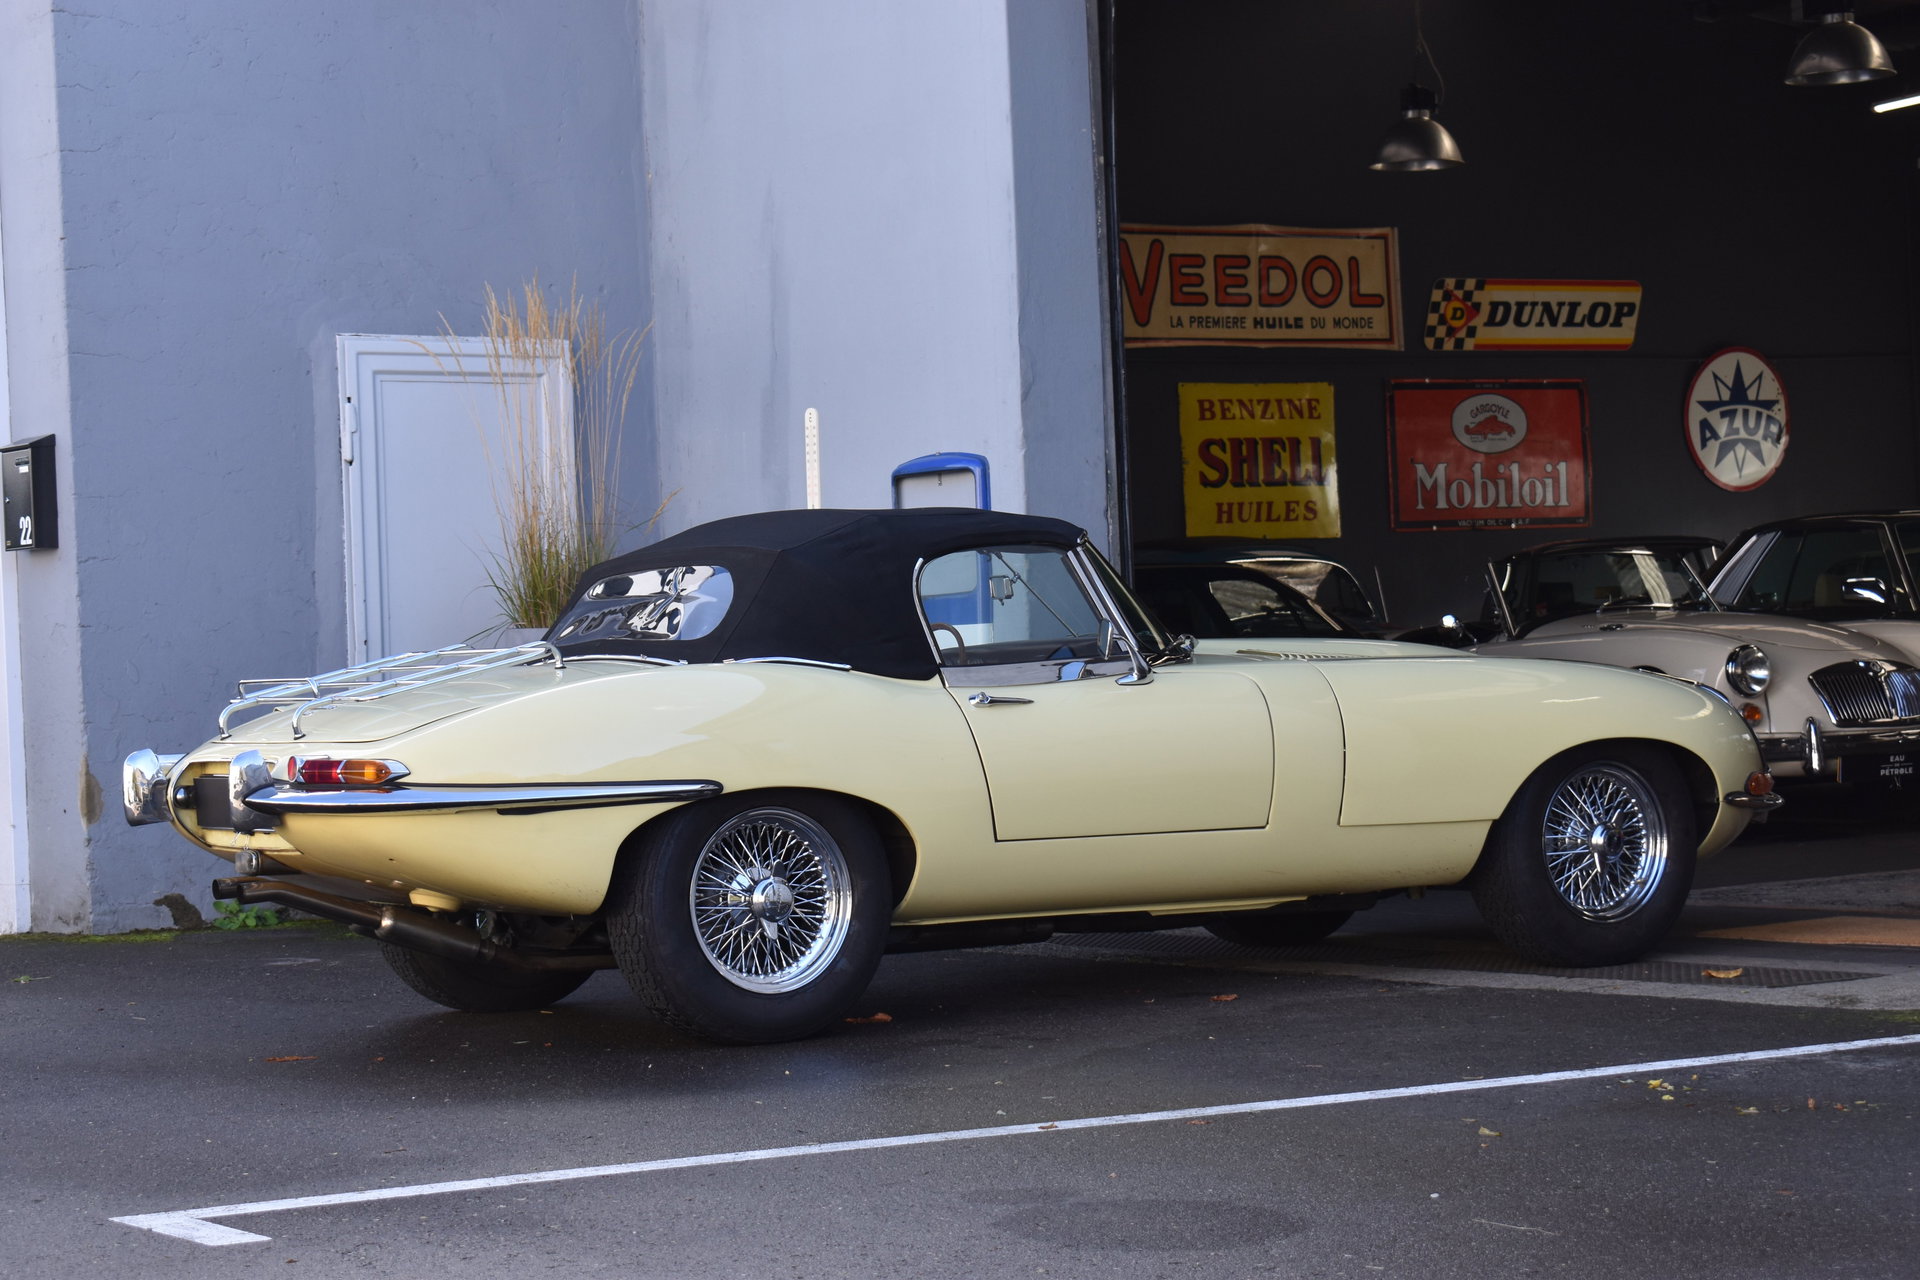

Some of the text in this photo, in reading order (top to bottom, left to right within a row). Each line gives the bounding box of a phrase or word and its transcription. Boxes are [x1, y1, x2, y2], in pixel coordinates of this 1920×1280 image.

[1119, 238, 1385, 328] VEEDOL
[1169, 316, 1184, 329] LA
[1253, 316, 1304, 329] HUILE
[1311, 316, 1326, 329] DU
[1333, 316, 1374, 330] MONDE
[1450, 307, 1465, 321] D
[1483, 301, 1637, 328] DUNLOP
[1196, 398, 1322, 421] BENZINE
[1470, 404, 1510, 419] GARGOYLE
[1699, 408, 1783, 451] AZUR
[1197, 437, 1331, 488] SHELL
[1414, 461, 1570, 510] Mobiloil
[1215, 500, 1318, 524] HUILES
[20, 516, 32, 545] 22
